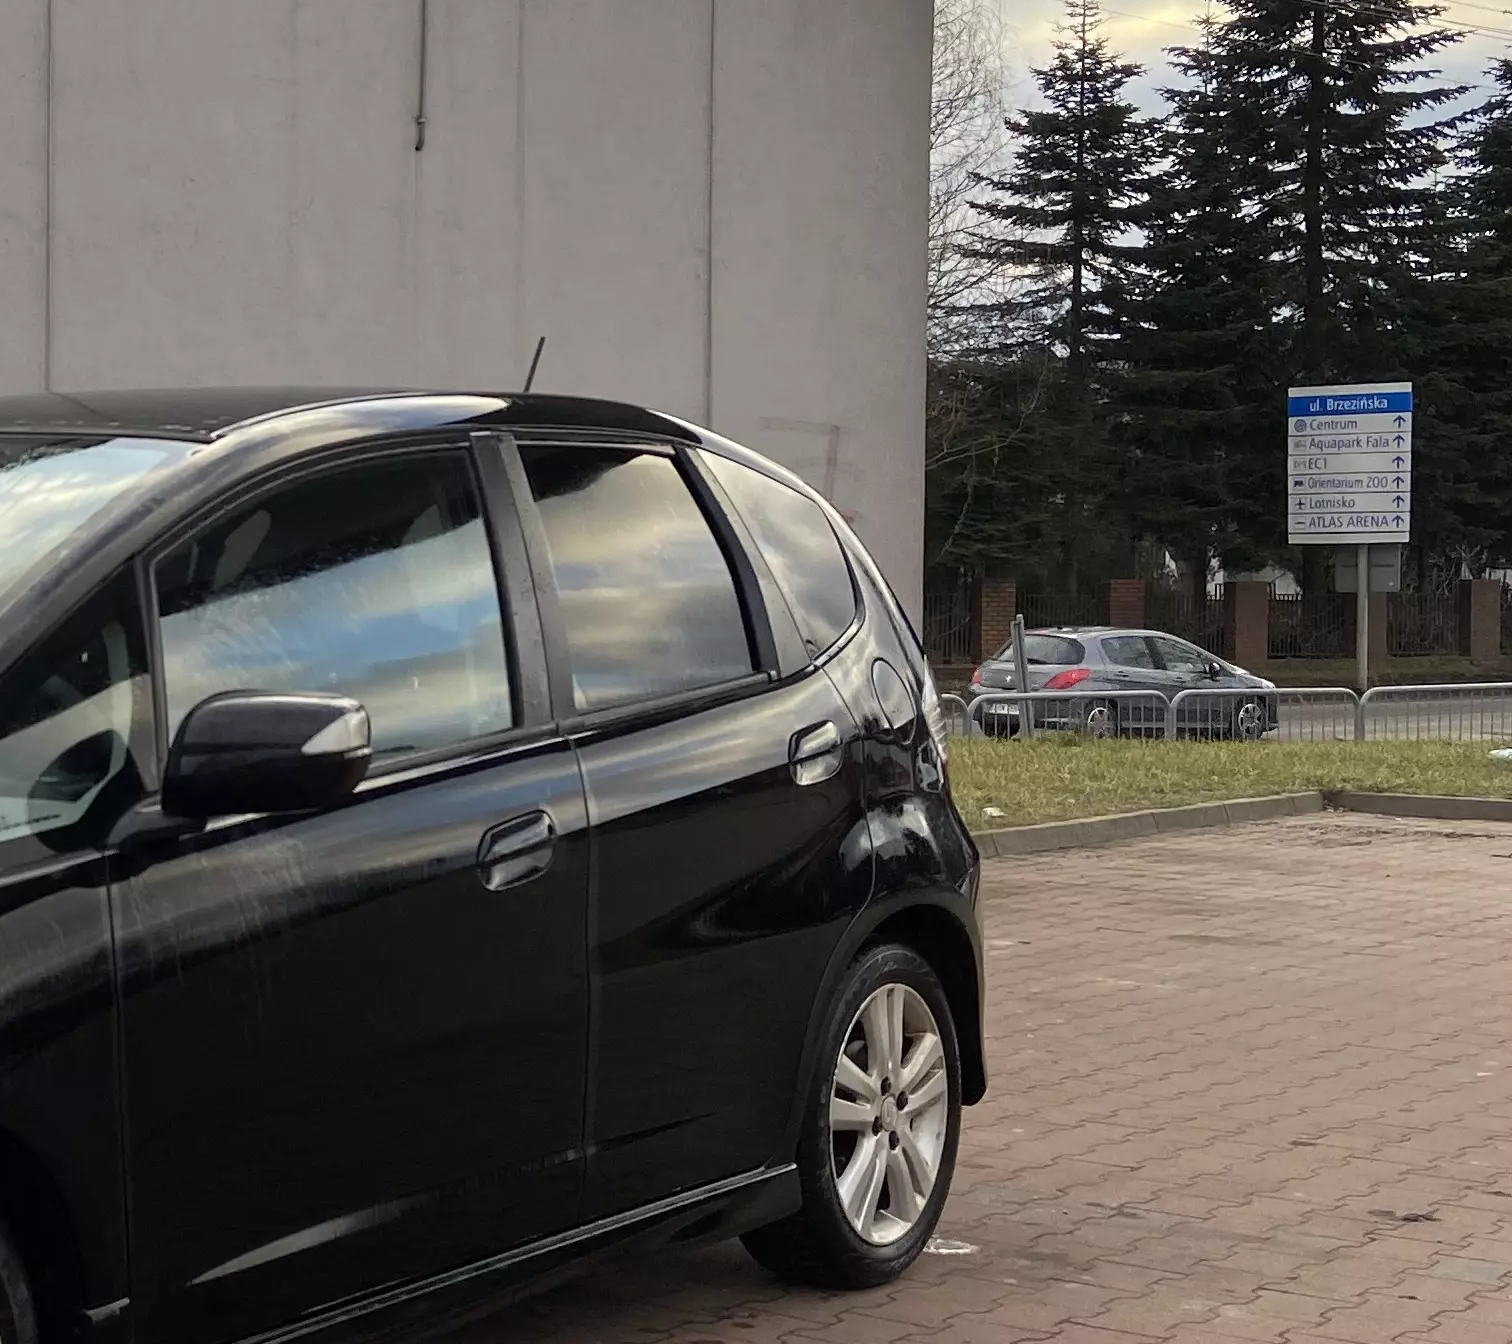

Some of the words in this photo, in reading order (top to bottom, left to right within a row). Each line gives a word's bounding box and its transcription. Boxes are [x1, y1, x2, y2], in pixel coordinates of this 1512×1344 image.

[1309, 398, 1323, 412] ul.
[1326, 396, 1388, 411] Brzezińska
[1309, 419, 1358, 431] Centrum
[1308, 437, 1363, 452] Aquapark
[1366, 436, 1390, 449] Fala
[1308, 458, 1328, 470] EC1
[1307, 477, 1364, 490] Orientarium
[1366, 476, 1389, 489] ZOO
[1309, 496, 1356, 509] Lotnisko
[1308, 516, 1343, 528] ATLAS
[1346, 515, 1390, 528] ARENA
